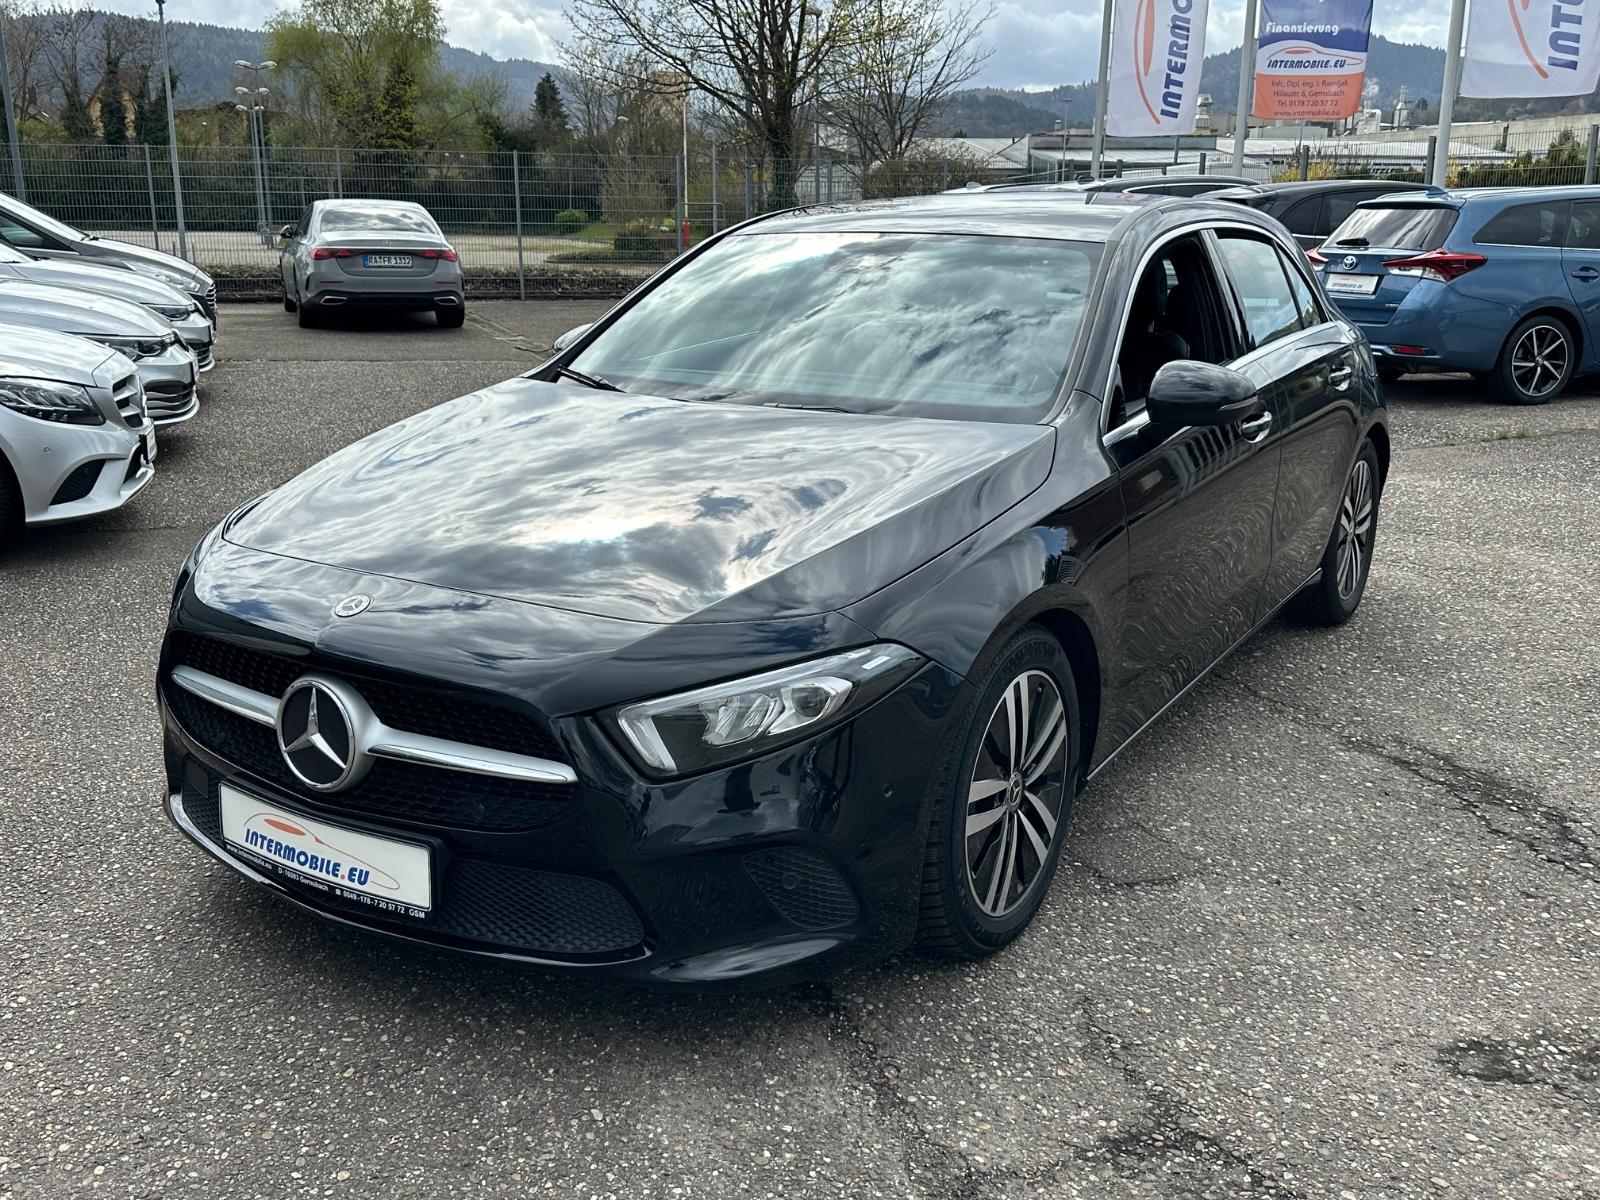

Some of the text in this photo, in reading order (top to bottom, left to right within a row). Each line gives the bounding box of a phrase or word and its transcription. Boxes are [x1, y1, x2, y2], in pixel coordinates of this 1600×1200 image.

[1265, 22, 1339, 36] Finanzierung
[1267, 59, 1347, 69] INTERMOBILE.EU
[1273, 109, 1341, 117] www.intermobile.eu
[368, 256, 378, 265] RA
[382, 256, 392, 265] FR
[244, 828, 370, 886] INTERMOBILE.EU
[379, 900, 387, 909] 20
[387, 903, 396, 911] 57
[397, 905, 405, 914] 72
[408, 908, 425, 919] GSM
